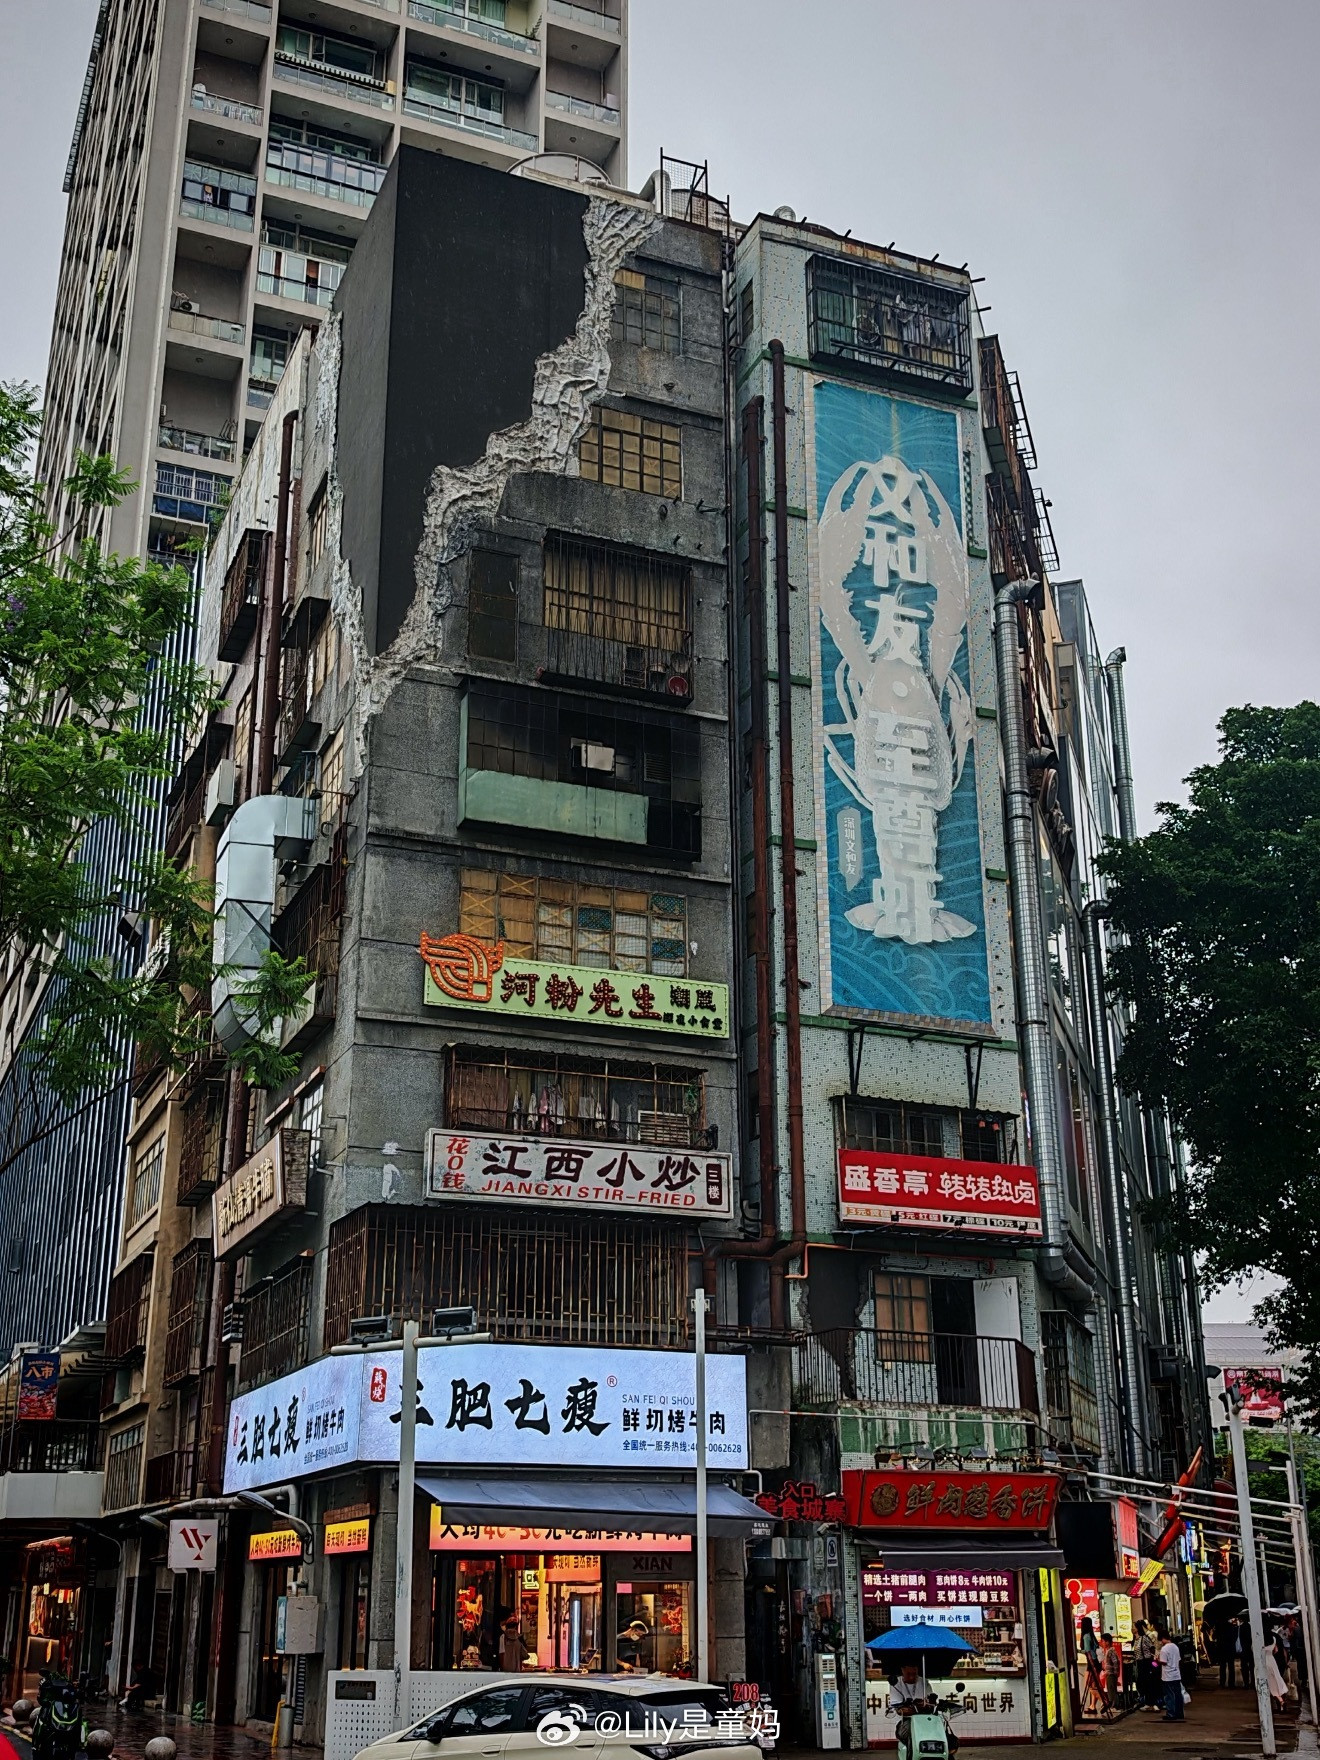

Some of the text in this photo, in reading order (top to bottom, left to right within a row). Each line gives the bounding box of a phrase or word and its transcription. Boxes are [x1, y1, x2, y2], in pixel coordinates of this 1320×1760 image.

[844, 817, 857, 875] 深圳文和友
[500, 970, 662, 1021] 河粉先生
[481, 1142, 701, 1192] 江西小炒
[481, 1179, 696, 1206] JIANGXI STIR-FRIED
[708, 1169, 720, 1199] 三楼
[844, 1165, 1036, 1206] 盛香亭 转转热卤
[25, 1366, 54, 1379] 八市
[390, 1377, 612, 1437] 三肥七瘦
[622, 1394, 695, 1406] SAN FEI QI SHOU
[237, 1394, 300, 1466] 三肥七瘦
[305, 1406, 345, 1445] 鲜切烤牛肉
[622, 1440, 742, 1453] 全国统一服务热线:4-0062628
[785, 1484, 814, 1498] 入口
[632, 1556, 673, 1571] XIAN
[864, 1574, 926, 1586] 精选土猪前腿肉
[972, 1574, 1008, 1587] 牛肉饼10元
[864, 1590, 1010, 1603] 一个饼 一两肉 买饼送现磨豆浆
[732, 1683, 760, 1702] 208
